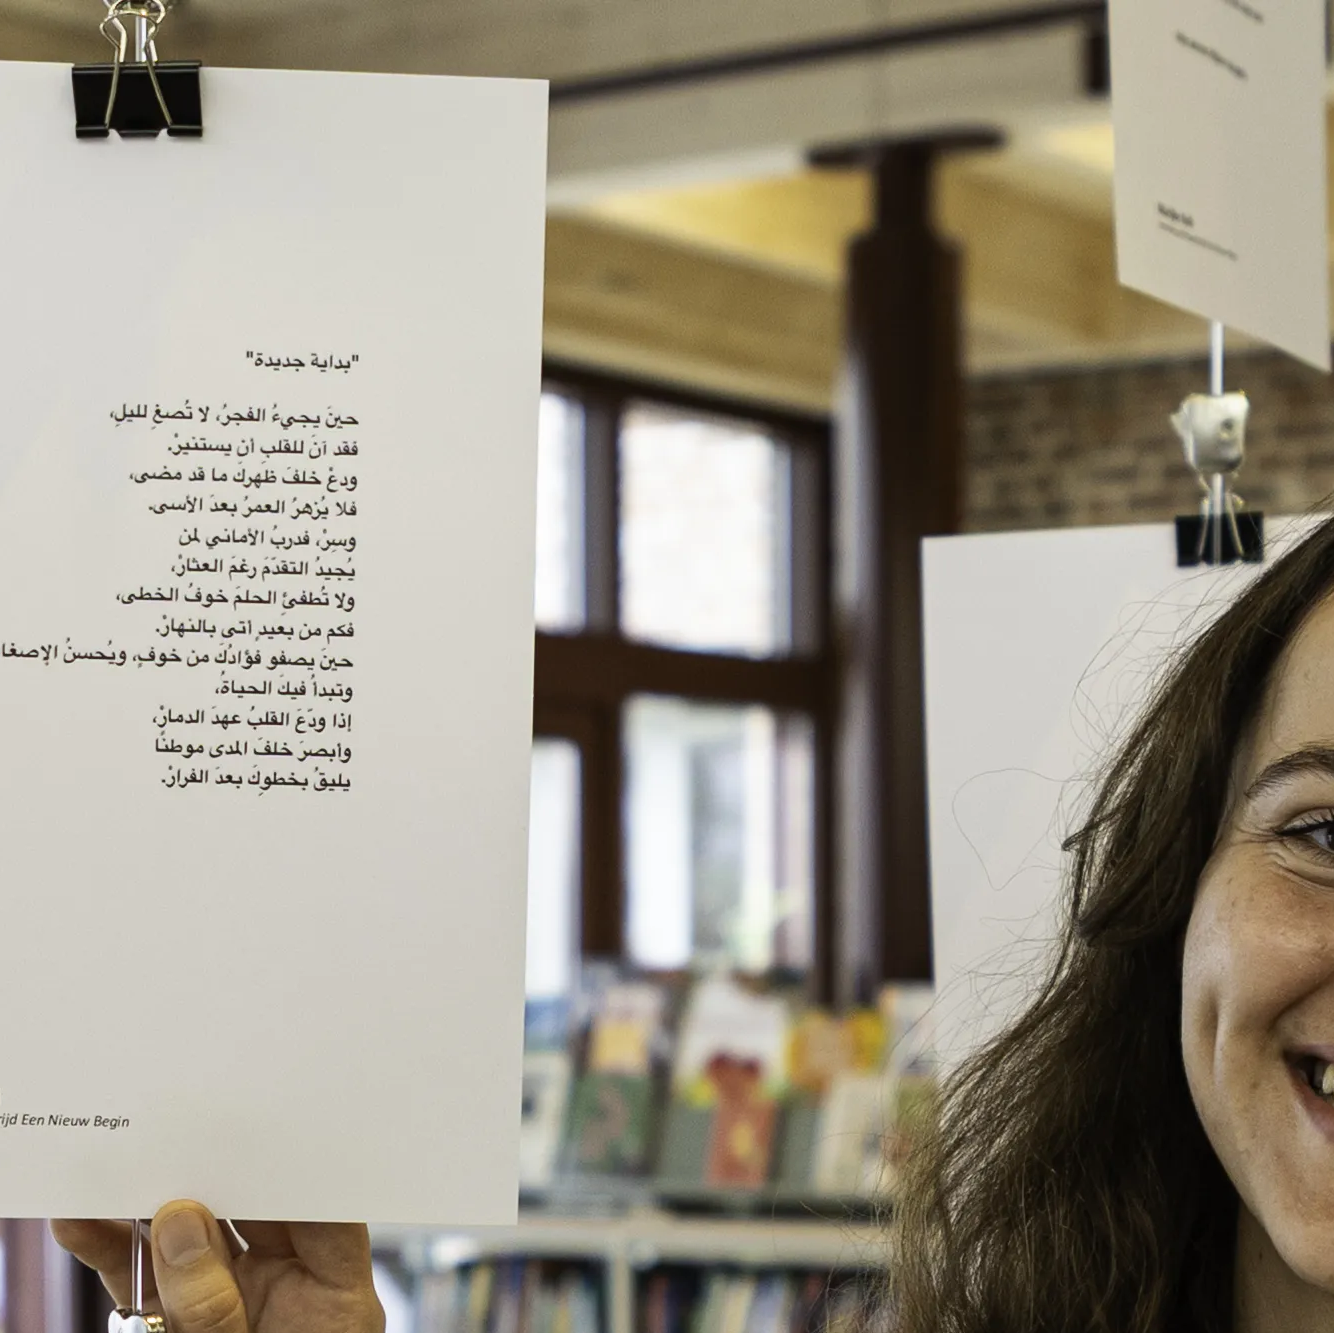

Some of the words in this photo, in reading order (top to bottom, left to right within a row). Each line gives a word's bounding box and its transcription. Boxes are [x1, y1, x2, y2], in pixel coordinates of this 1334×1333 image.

[246, 351, 305, 372] جديدة"
[311, 353, 359, 373] "بداية
[198, 406, 210, 422] لا
[237, 438, 254, 457] أن
[333, 441, 358, 456] فقد
[129, 466, 182, 484] مضى،
[188, 467, 205, 481] قد
[212, 468, 228, 482] ما
[148, 495, 203, 514] الأسى.
[336, 501, 357, 516] فلا
[179, 528, 201, 546] لمن
[205, 528, 264, 550] الأماني
[116, 586, 178, 604] الخطى،
[334, 592, 355, 612] ولا
[221, 620, 252, 638] أتى
[299, 623, 321, 640] من
[327, 622, 354, 644] فكم
[187, 650, 209, 667] من
[266, 650, 315, 670] يصفو
[333, 713, 351, 732] إذا
[209, 740, 248, 758] المدى
[21, 1114, 45, 1126] Een
[48, 1114, 90, 1126] Nieuw
[94, 1115, 129, 1130] Begin
